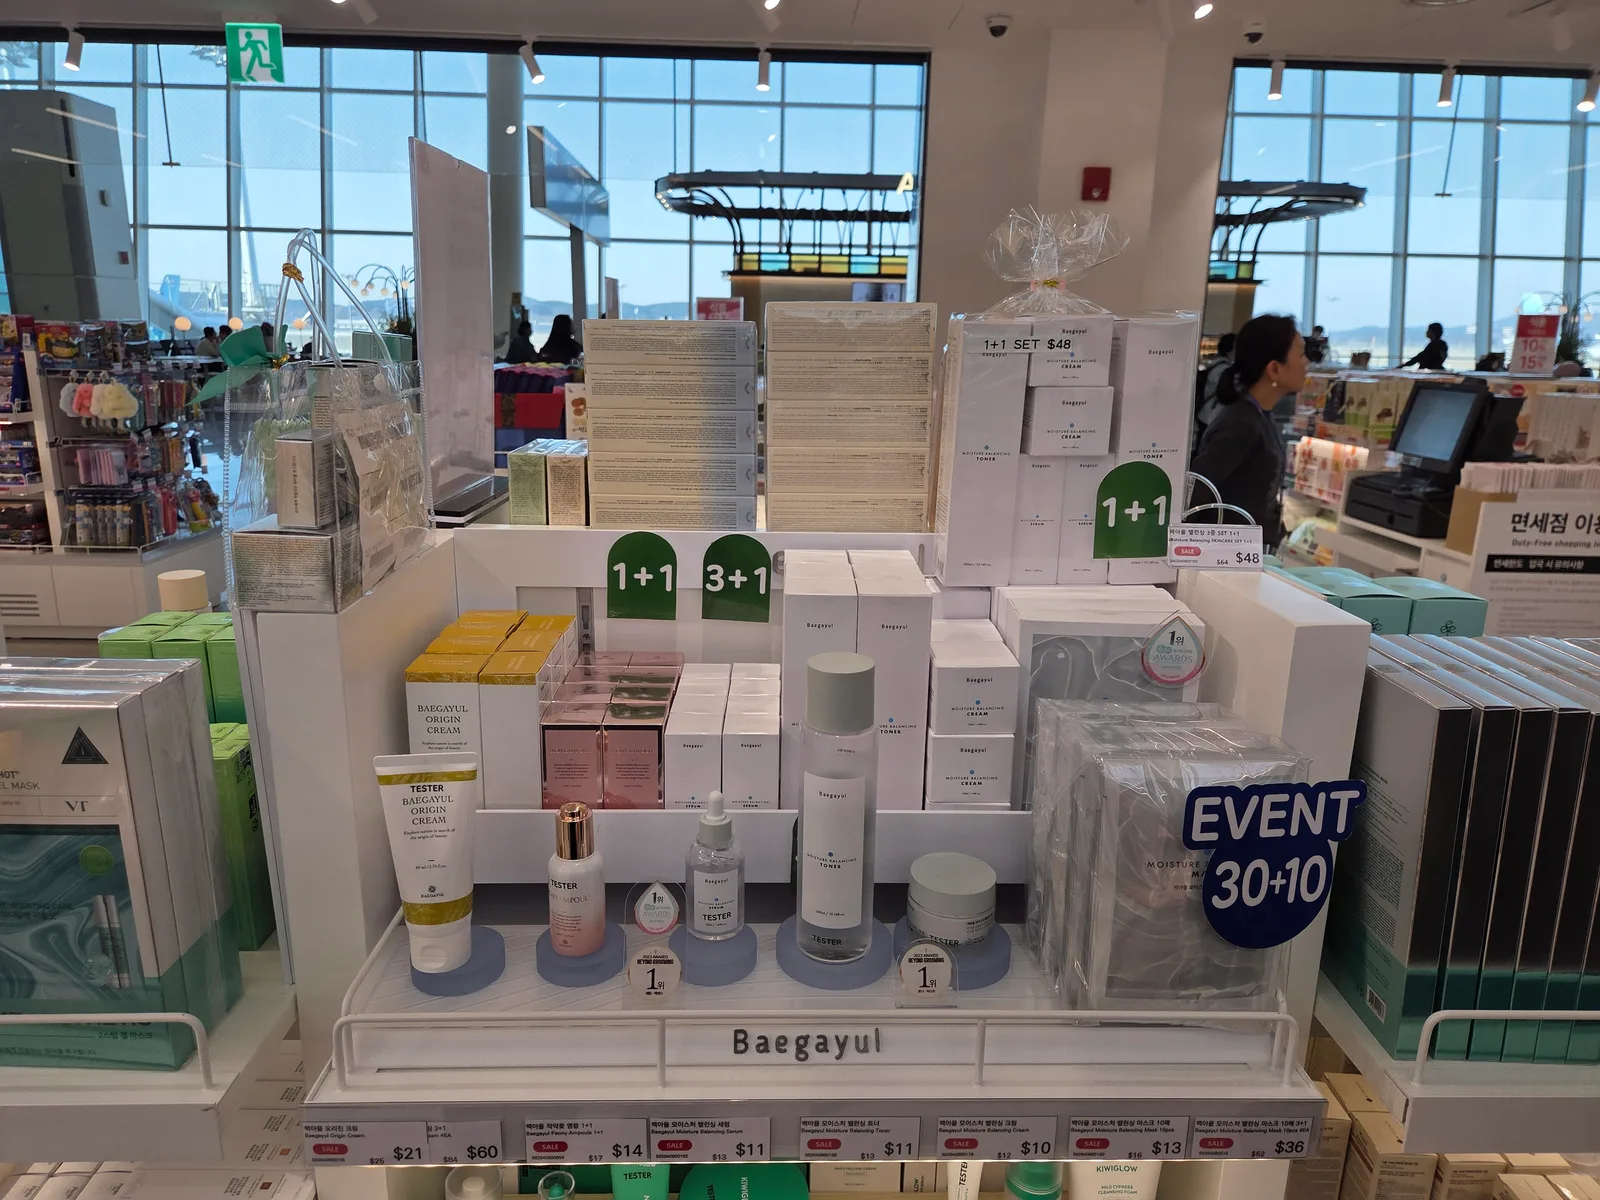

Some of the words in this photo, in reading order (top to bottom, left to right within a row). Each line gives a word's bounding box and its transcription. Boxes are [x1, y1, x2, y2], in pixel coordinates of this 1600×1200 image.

[984, 339, 1006, 350] 1+1
[1014, 339, 1040, 350] SET
[1048, 339, 1071, 350] $48
[1103, 495, 1167, 528] 1+1
[1511, 512, 1569, 534] 면세점
[1512, 539, 1552, 548] Duty-Free
[1236, 552, 1259, 564] $48
[612, 562, 673, 592] 1+1
[705, 563, 767, 594] 3+1
[1169, 631, 1184, 645] 1위
[1154, 654, 1193, 663] AWARDS
[418, 705, 468, 713] BAEGAYUL
[410, 785, 444, 793] TESTER
[819, 791, 847, 799] Baegayul
[403, 796, 454, 805] BAEGAYUL
[411, 806, 446, 815] ORIGIN
[1191, 789, 1360, 842] EVENT
[412, 816, 446, 825] CREAM
[551, 879, 578, 890] TESTER
[1212, 855, 1327, 910] 30+10
[652, 892, 663, 904] 1위
[703, 912, 732, 921] TESTER
[812, 934, 842, 946] TESTER
[929, 934, 960, 947] TESTER
[646, 968, 665, 990] 1위
[918, 966, 937, 988] 1위
[733, 1028, 882, 1062] Baegayul
[394, 1146, 422, 1161] $21
[467, 1145, 498, 1160] $60
[612, 1144, 643, 1158] $14
[736, 1142, 763, 1157] $11
[884, 1142, 912, 1156] $11
[1021, 1141, 1051, 1155] $10
[1152, 1141, 1181, 1155] $13
[1275, 1140, 1305, 1155] $36
[370, 1157, 385, 1165] $25
[623, 1172, 652, 1180] TESTER
[741, 1177, 749, 1200] KIWIG
